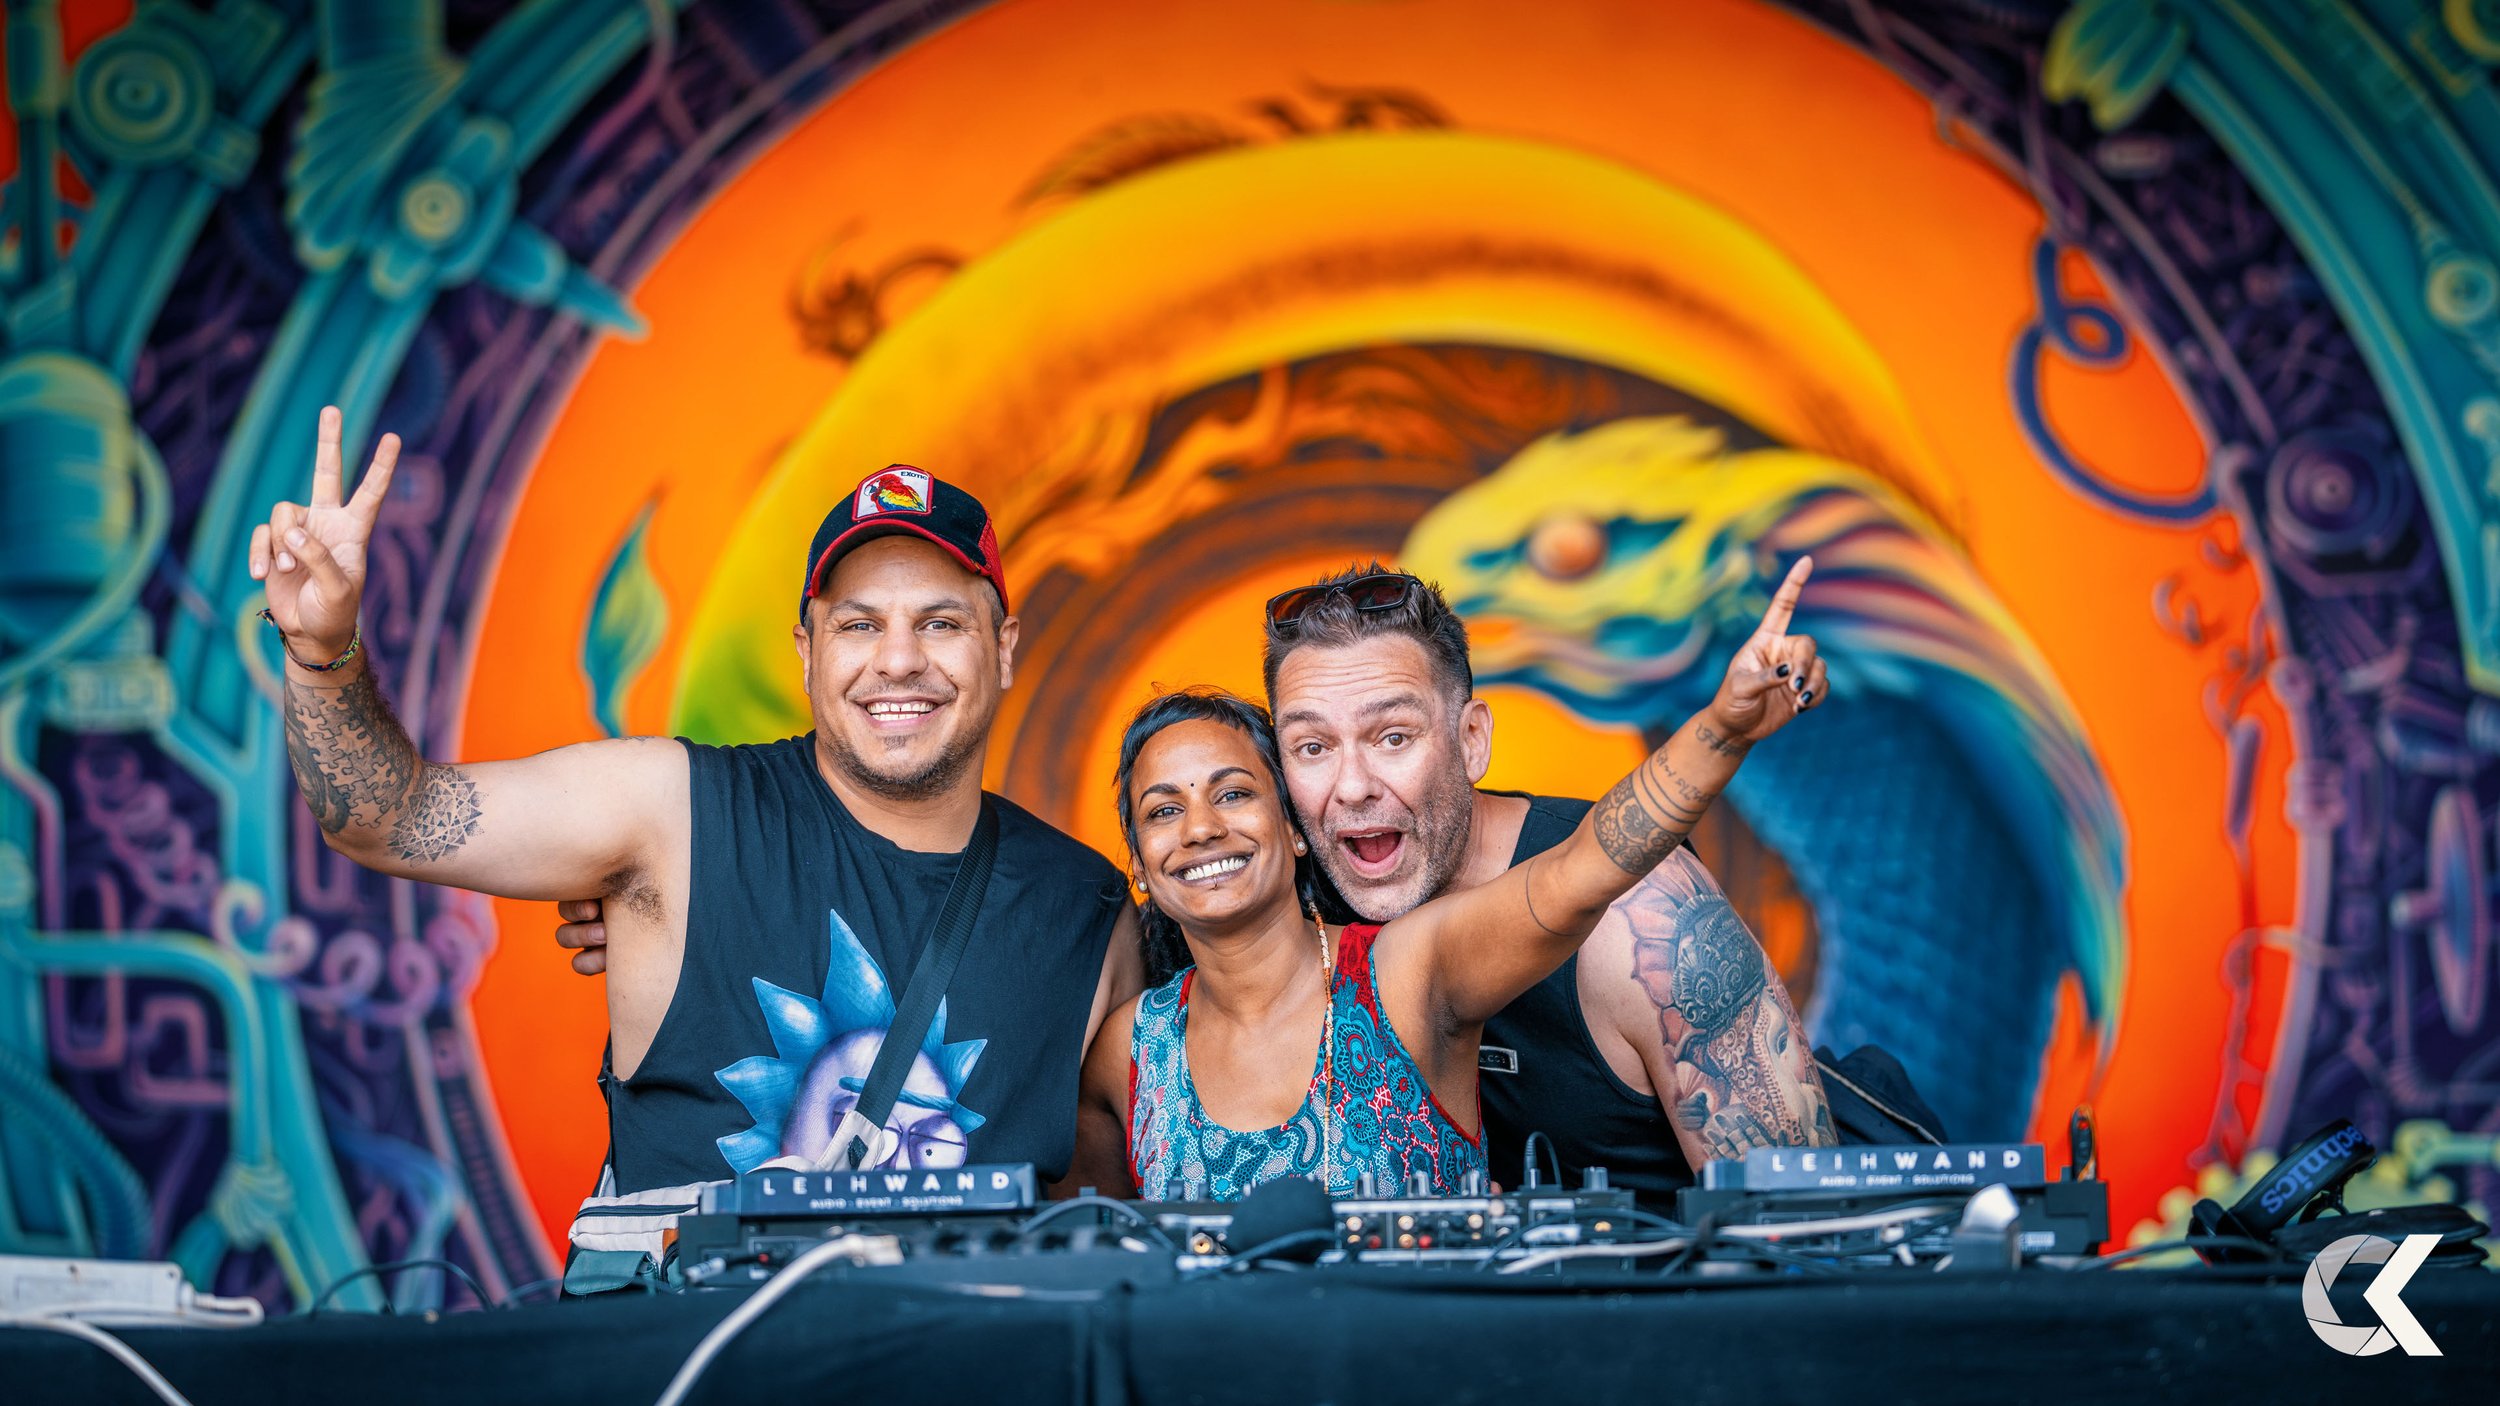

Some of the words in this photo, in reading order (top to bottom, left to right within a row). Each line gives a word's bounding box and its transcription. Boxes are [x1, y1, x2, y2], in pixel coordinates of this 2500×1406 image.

[1771, 1149, 2022, 1173] LEIHWAND
[2260, 1125, 2365, 1214] echnics
[762, 1172, 1010, 1197] LEIHWAND
